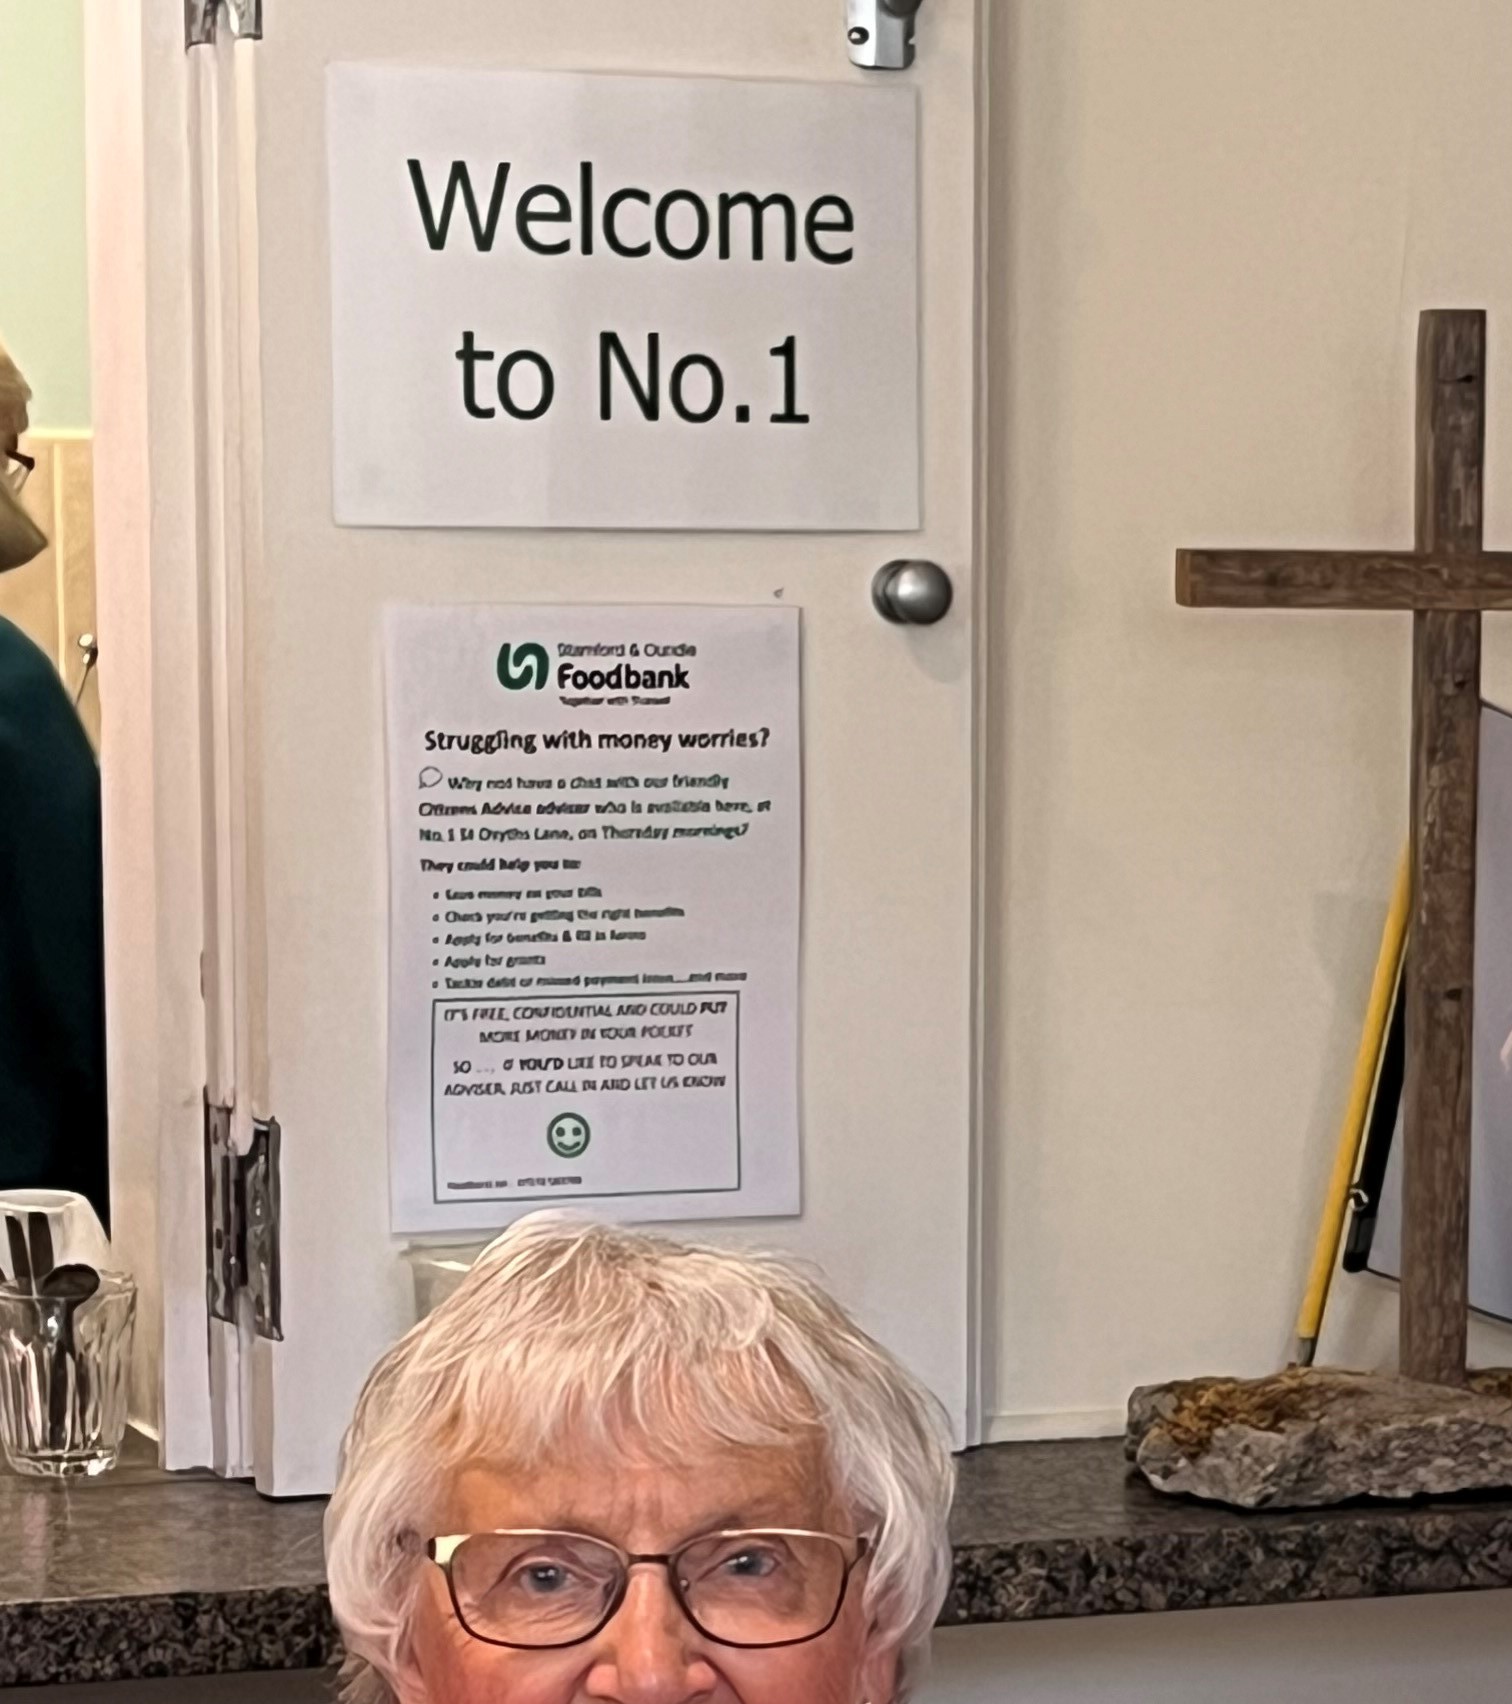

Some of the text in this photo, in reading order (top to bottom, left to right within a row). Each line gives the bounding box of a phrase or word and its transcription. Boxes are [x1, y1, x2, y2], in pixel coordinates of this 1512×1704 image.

[406, 158, 855, 264] Welcome
[455, 331, 810, 424] to No.1
[629, 643, 640, 656] &
[557, 663, 691, 690] Foodbank
[424, 728, 771, 754] Struggling with money worries?
[448, 777, 483, 791] Why
[517, 777, 553, 789] have
[557, 779, 566, 789] a
[570, 777, 602, 789] chat
[606, 776, 640, 788] with
[644, 777, 669, 788] our
[673, 774, 730, 789] friendly
[481, 802, 532, 815] Advice
[595, 801, 627, 814] who
[631, 800, 643, 813] is
[578, 829, 598, 840] on
[420, 859, 454, 873] They
[457, 858, 496, 871] could
[499, 858, 531, 872] help
[534, 861, 560, 872] you
[445, 934, 482, 946] Apply
[485, 932, 504, 944] for
[444, 956, 482, 968] Apply
[650, 1003, 698, 1015] COULD
[453, 1061, 472, 1073] SO
[545, 1080, 578, 1093] CALL
